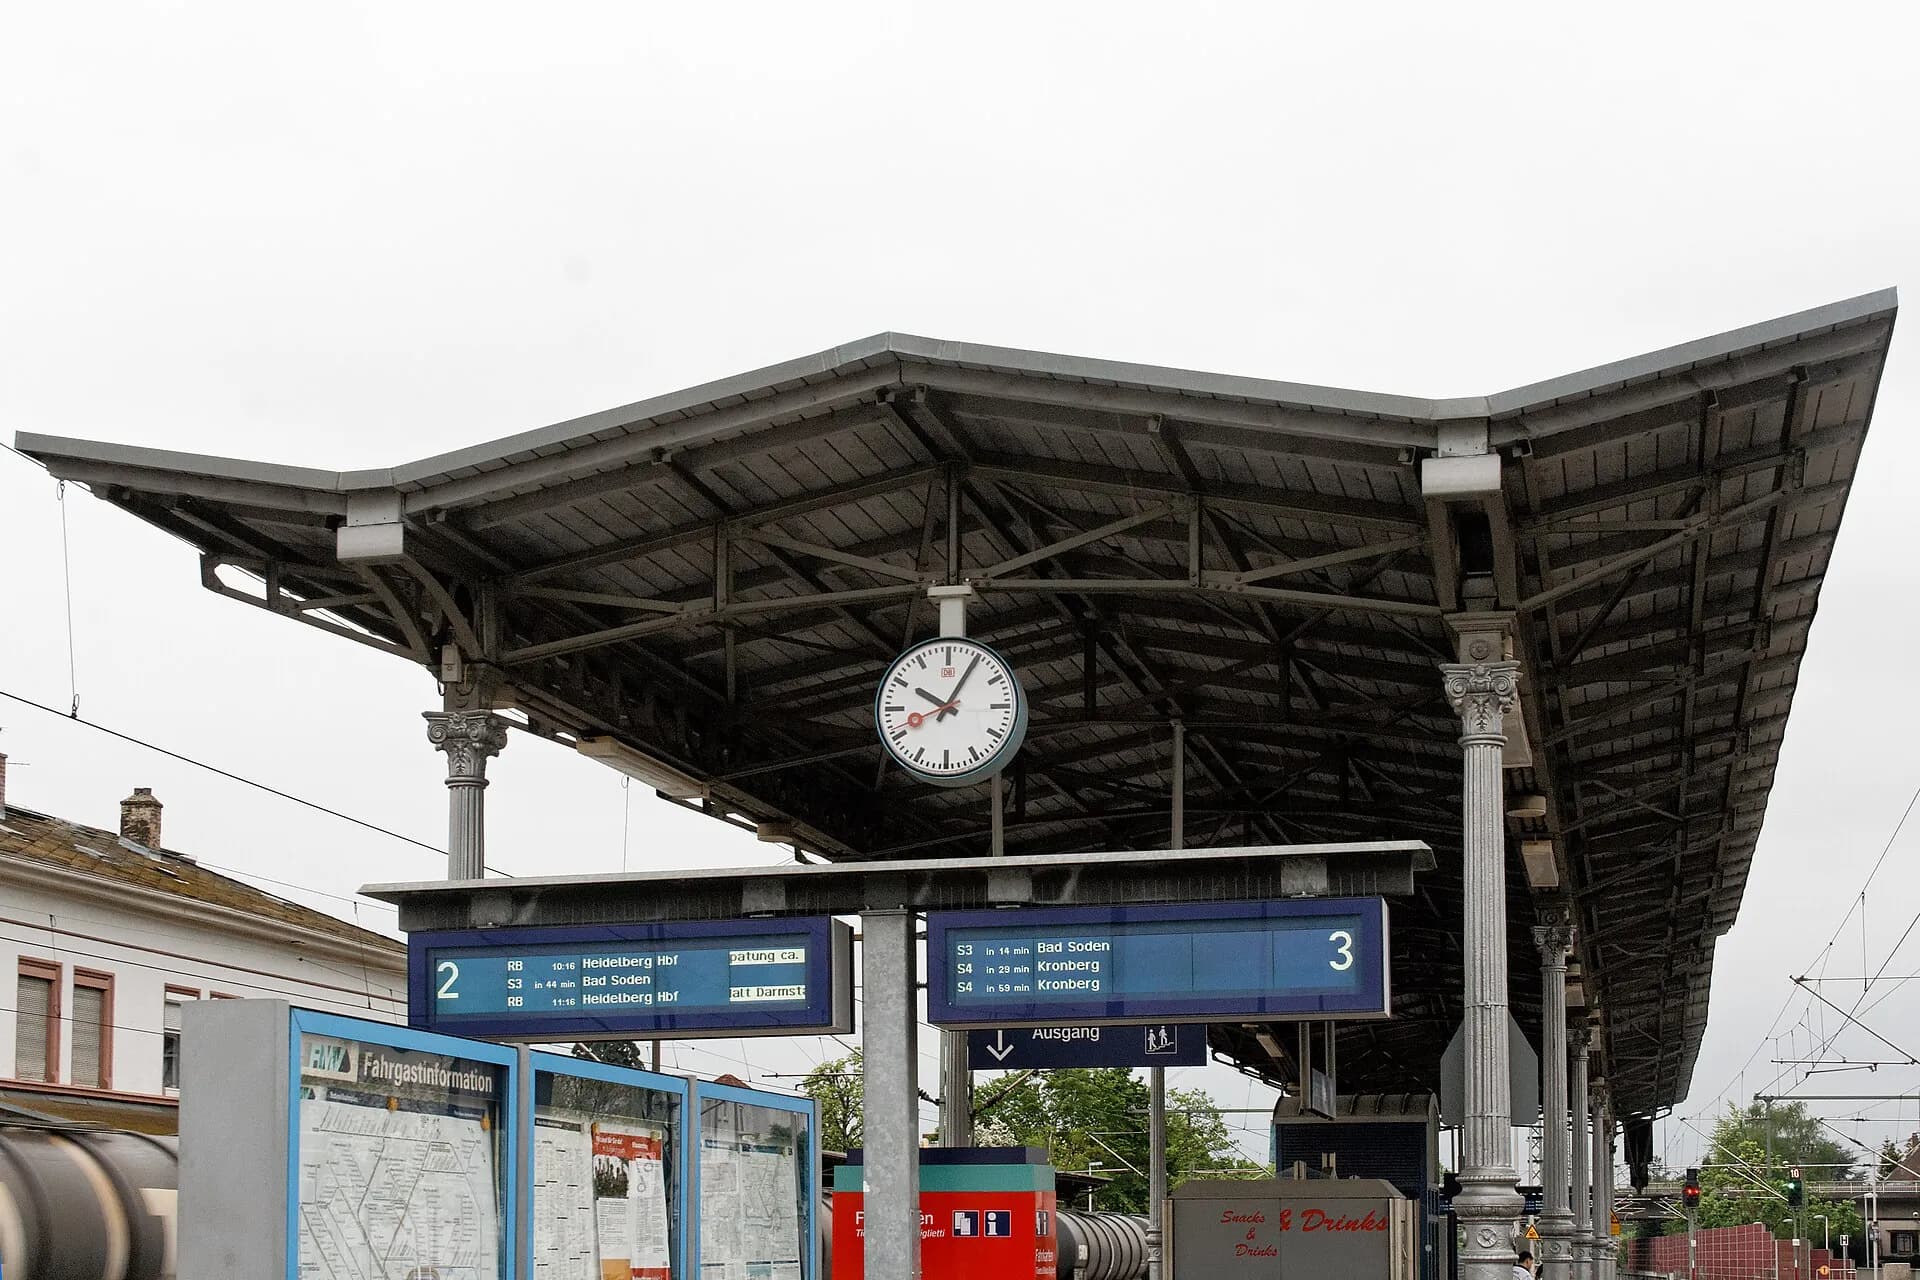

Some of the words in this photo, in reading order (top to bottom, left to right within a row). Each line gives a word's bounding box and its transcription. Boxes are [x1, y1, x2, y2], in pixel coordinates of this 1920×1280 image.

[957, 945, 972, 956] S3
[1038, 942, 1062, 952] Bad
[1068, 941, 1110, 952] Soden
[1328, 931, 1354, 971] 3
[508, 961, 523, 971] RB
[582, 957, 652, 968] Heidelberg
[658, 955, 678, 965] Hbf
[957, 964, 973, 974] S4
[1038, 960, 1099, 972] Kronberg
[437, 961, 459, 998] 2
[508, 979, 522, 989] S3
[583, 976, 606, 986] Bad
[611, 975, 650, 985] Soden
[958, 982, 973, 992] S4
[1038, 979, 1099, 991] Kronberg
[508, 997, 523, 1006] RB
[582, 993, 652, 1004] Heidelberg
[658, 991, 679, 1002] Hbf
[1032, 1027, 1099, 1042] Ausgang
[364, 1052, 492, 1093] Fahrgastinformation
[1791, 1169, 1799, 1178] 10
[1220, 1211, 1264, 1223] Snacks
[1300, 1209, 1388, 1232] Drinks
[920, 1229, 945, 1239] iglietti
[1246, 1227, 1255, 1240] &
[1236, 1244, 1277, 1256] Drinks
